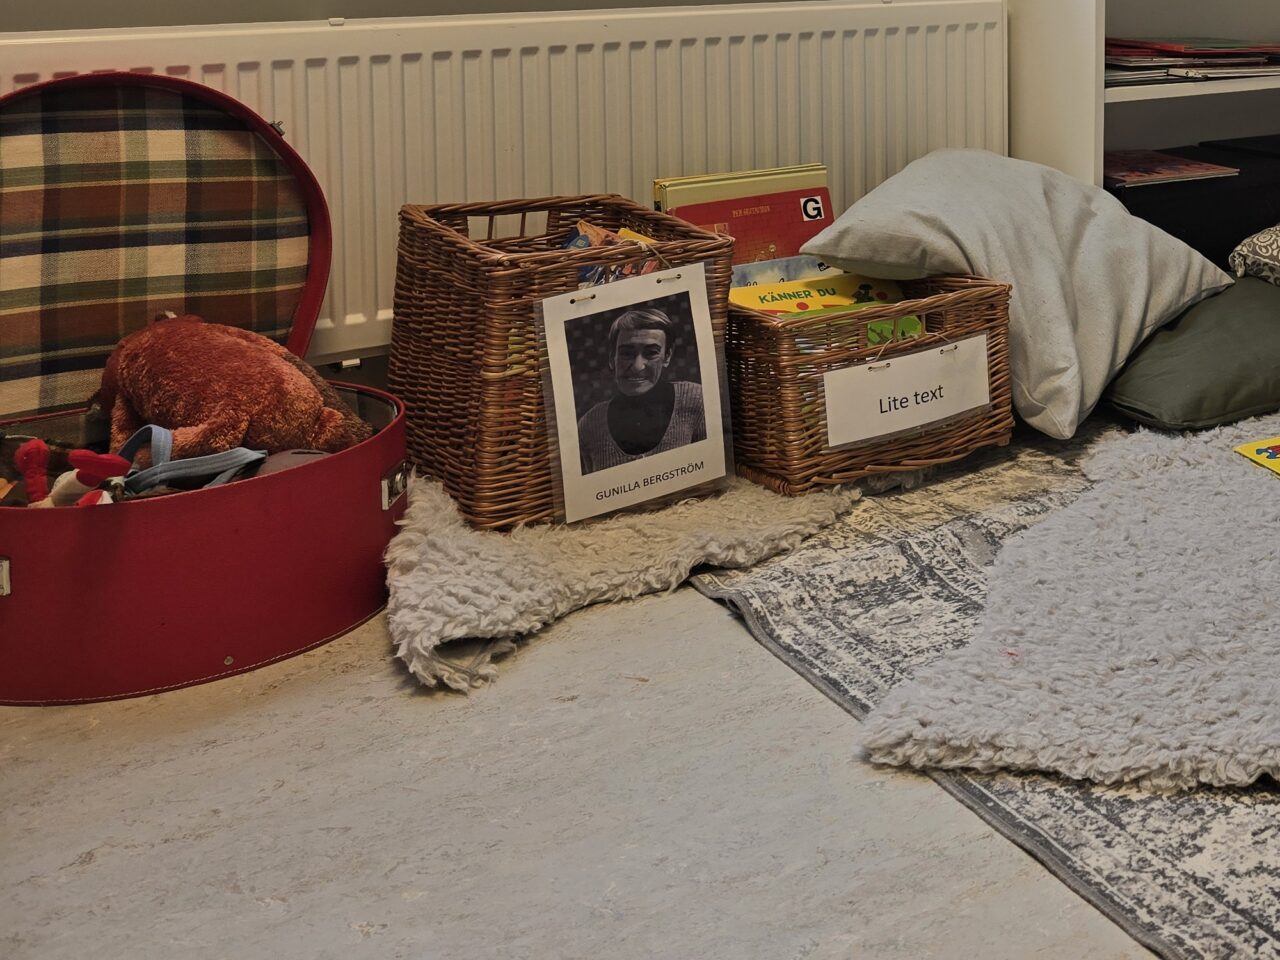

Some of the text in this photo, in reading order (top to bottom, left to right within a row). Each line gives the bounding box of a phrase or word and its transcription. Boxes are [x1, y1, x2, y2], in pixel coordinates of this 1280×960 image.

[802, 197, 823, 220] G
[758, 287, 837, 304] KÄNNER DU
[879, 384, 944, 415] Lite text
[595, 460, 705, 502] GUNILLA BERGSTRÖM
